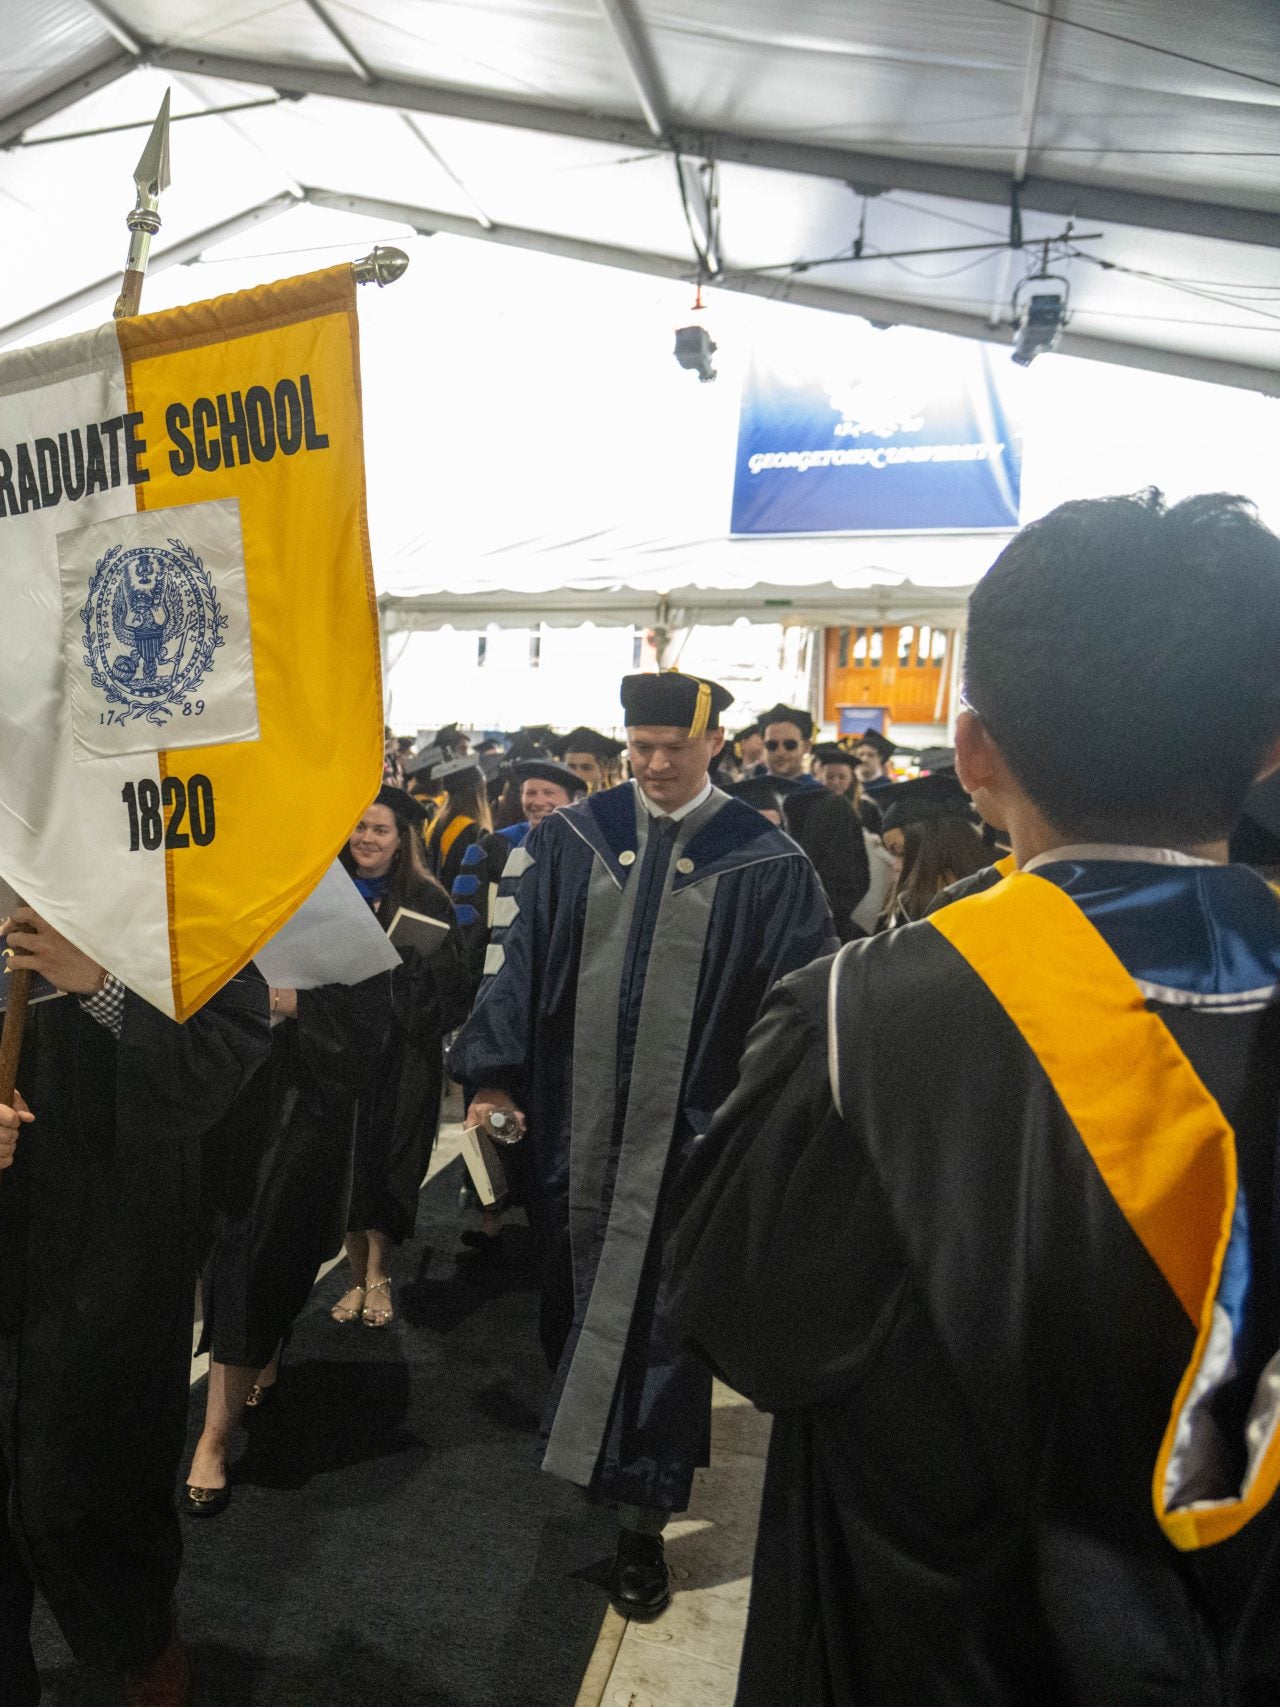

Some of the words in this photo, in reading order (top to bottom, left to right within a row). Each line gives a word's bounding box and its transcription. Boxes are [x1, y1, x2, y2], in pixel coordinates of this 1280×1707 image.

[165, 374, 329, 477] SCHOOL
[99, 709, 115, 726] 17
[182, 699, 205, 717] 89
[121, 773, 216, 852] 1820
